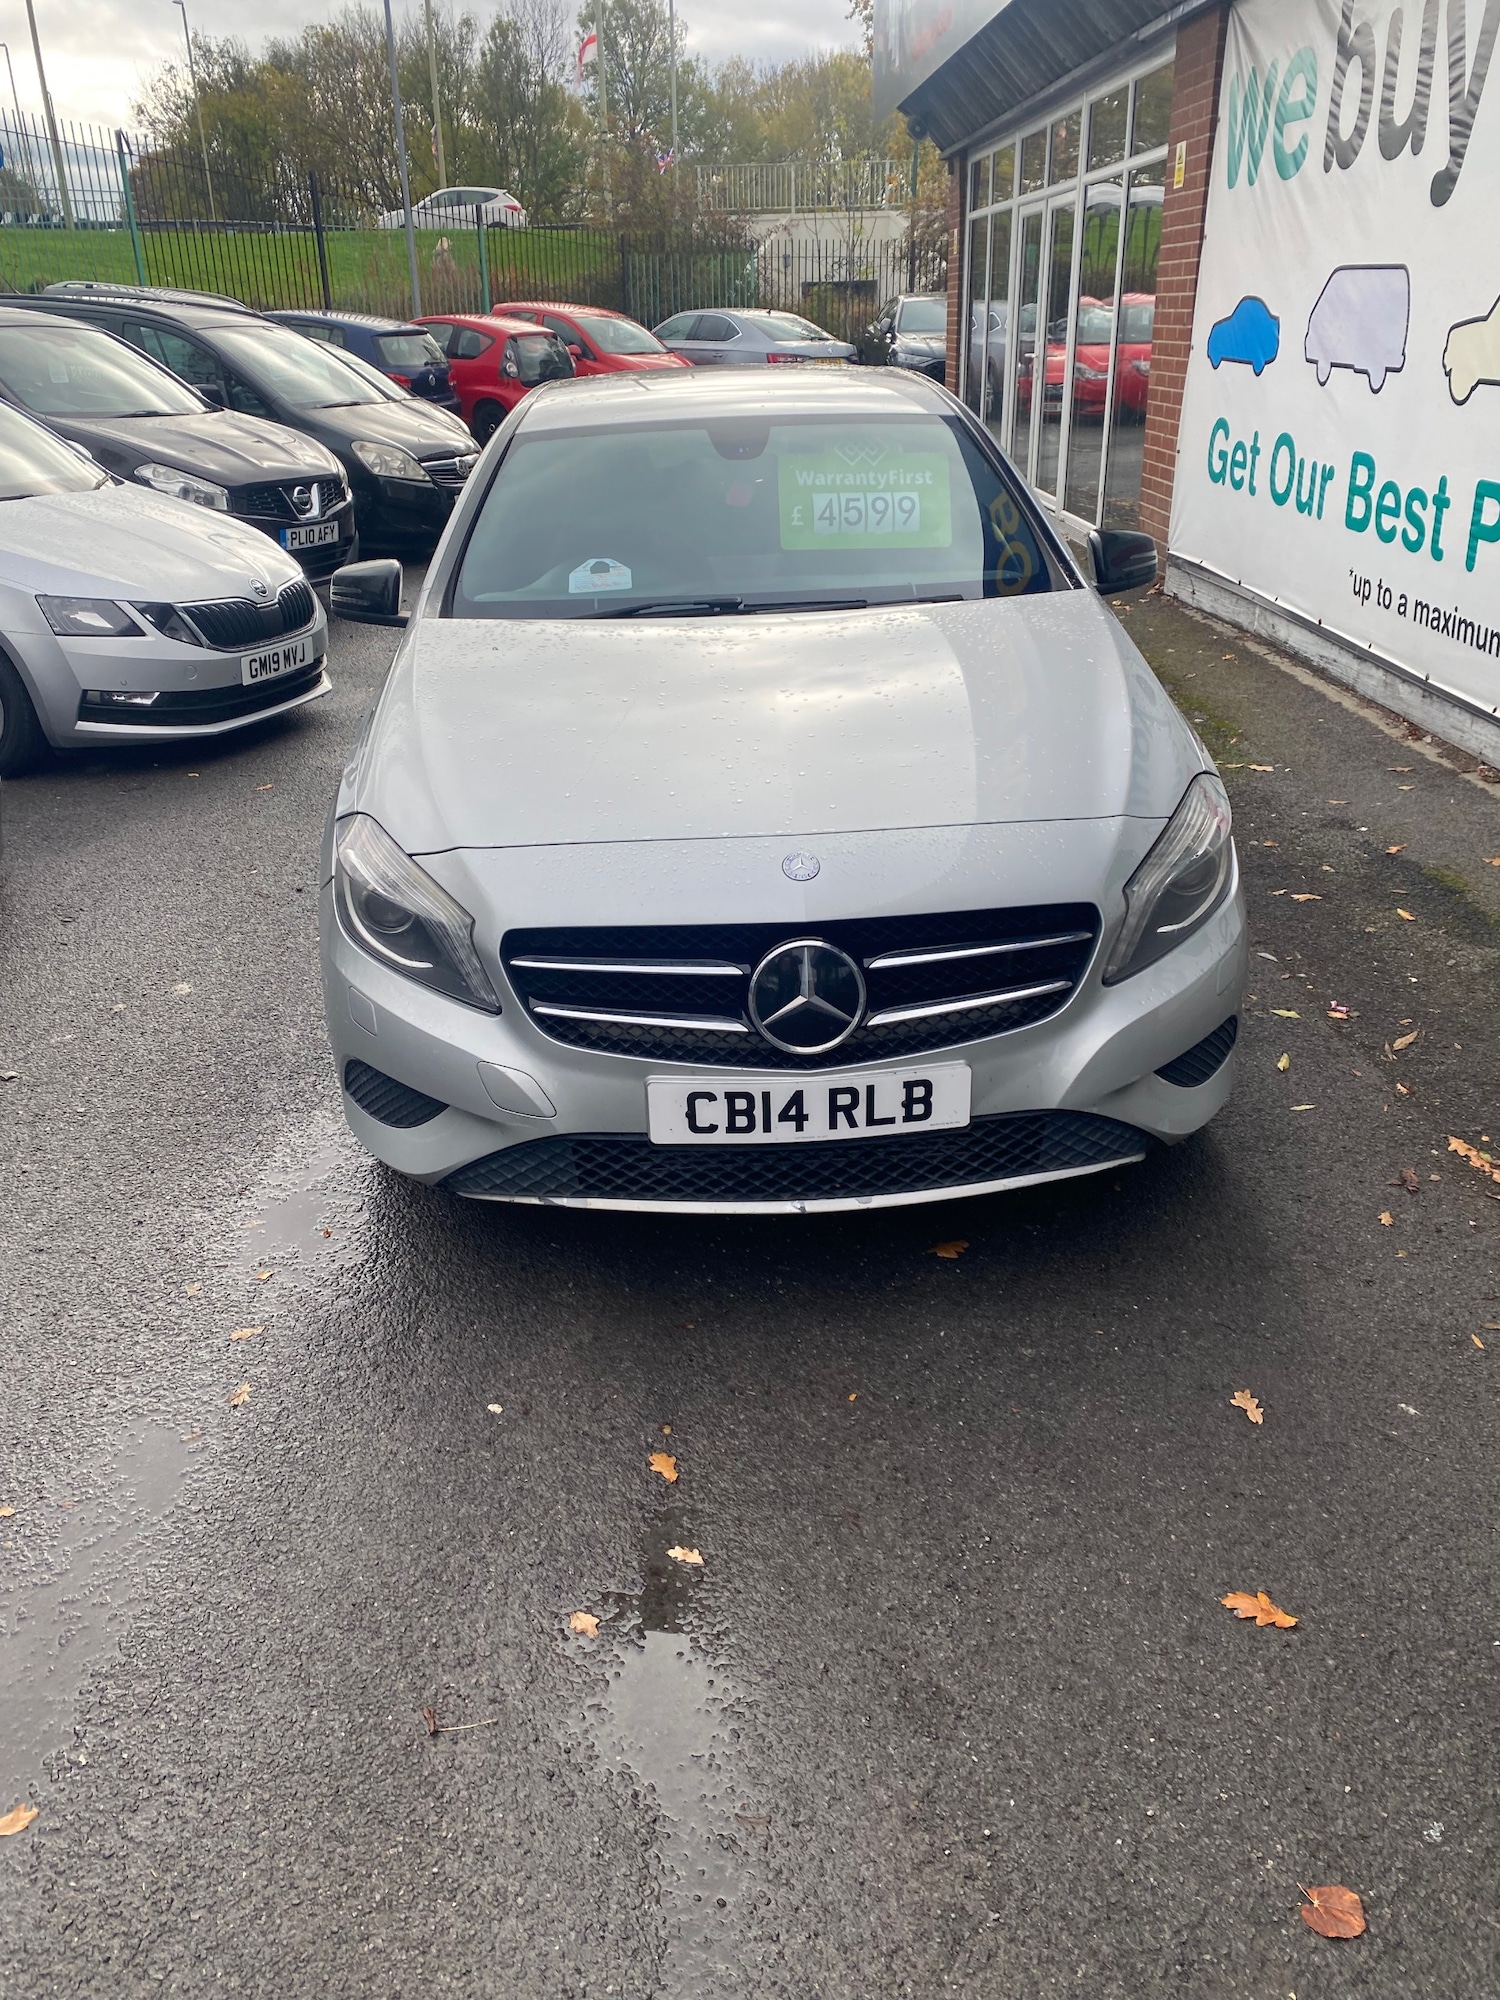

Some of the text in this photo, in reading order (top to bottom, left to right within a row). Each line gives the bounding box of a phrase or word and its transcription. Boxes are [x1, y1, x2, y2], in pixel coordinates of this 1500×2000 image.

[795, 468, 934, 490] WarrantyFirst
[1207, 416, 1261, 497] Get
[1269, 431, 1335, 520] Our
[1345, 450, 1451, 562] Best
[792, 495, 917, 527] £ 4599
[290, 523, 335, 547] PL10 AFY
[1377, 578, 1392, 610] to
[1397, 593, 1408, 618] a
[249, 642, 305, 679] GM19 MVJ
[685, 1078, 934, 1135] CB14 RLB
